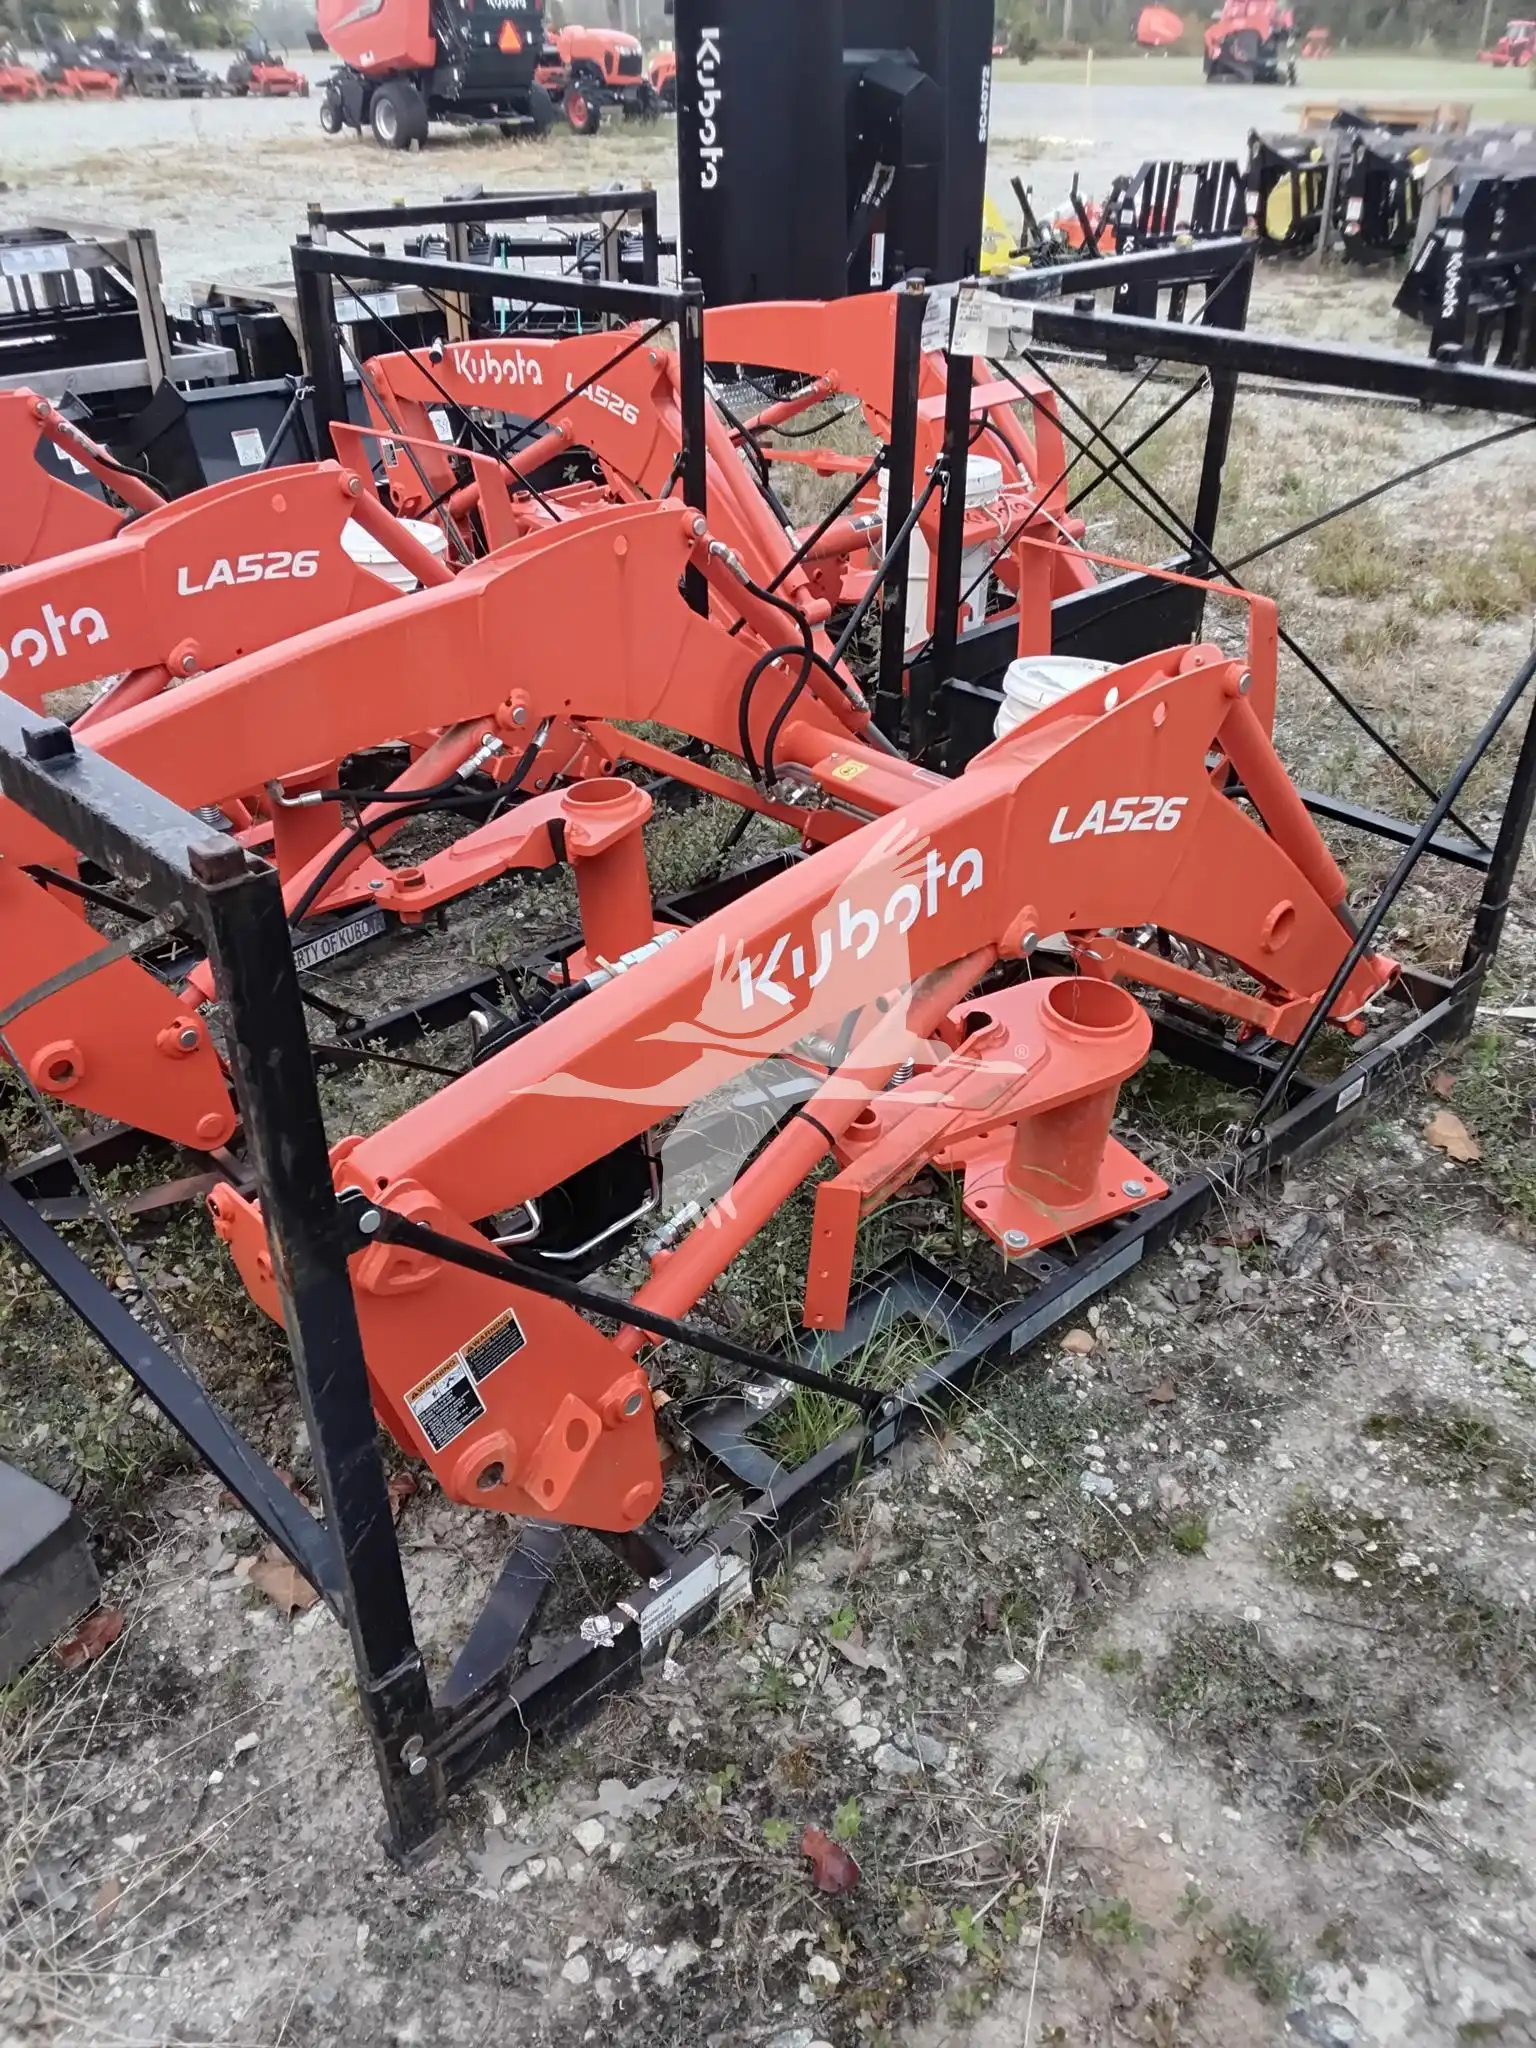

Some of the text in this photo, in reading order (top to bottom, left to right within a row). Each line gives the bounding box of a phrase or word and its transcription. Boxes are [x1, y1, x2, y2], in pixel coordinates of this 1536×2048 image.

[696, 27, 723, 189] Kubota
[978, 65, 991, 143] SC4072
[1441, 252, 1463, 318] Kubota
[453, 349, 543, 385] Kubota
[178, 550, 320, 596] LA526
[1049, 795, 1189, 844] LA526
[296, 914, 385, 968] RTY OF KUBOTA
[738, 847, 984, 1010] Kubota
[416, 1359, 457, 1396] WARNING
